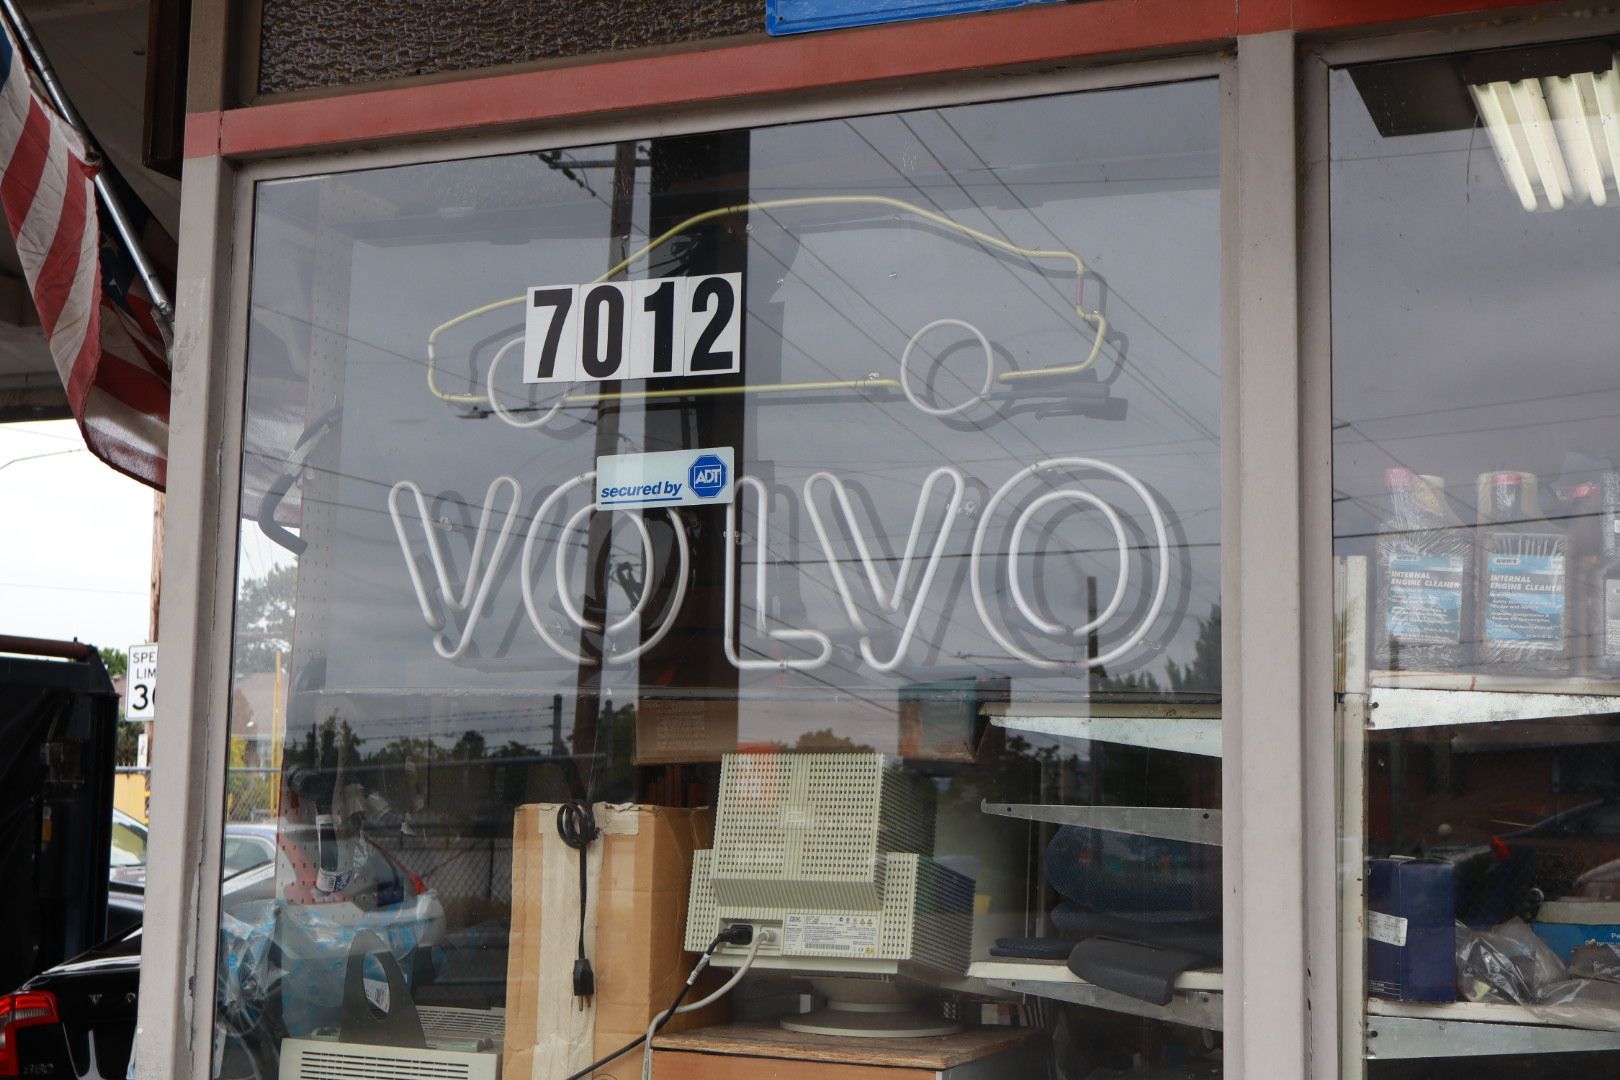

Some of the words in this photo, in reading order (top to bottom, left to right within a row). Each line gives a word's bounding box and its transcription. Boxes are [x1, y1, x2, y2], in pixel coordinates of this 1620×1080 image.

[533, 276, 735, 379] 7012
[695, 468, 721, 484] ADT
[600, 481, 662, 498] secured
[663, 480, 682, 496] by
[387, 457, 1169, 672] VOLVO
[1391, 570, 1430, 578] INTERNAL
[1490, 574, 1531, 583] INTERNAL
[1390, 578, 1421, 586] ENGINE
[1424, 579, 1461, 589] CLEANER
[1490, 582, 1522, 590] ENGINE
[1525, 583, 1562, 592] CLEANER
[132, 652, 156, 664] SPE
[136, 667, 157, 679] LIM
[132, 684, 156, 711] 3
